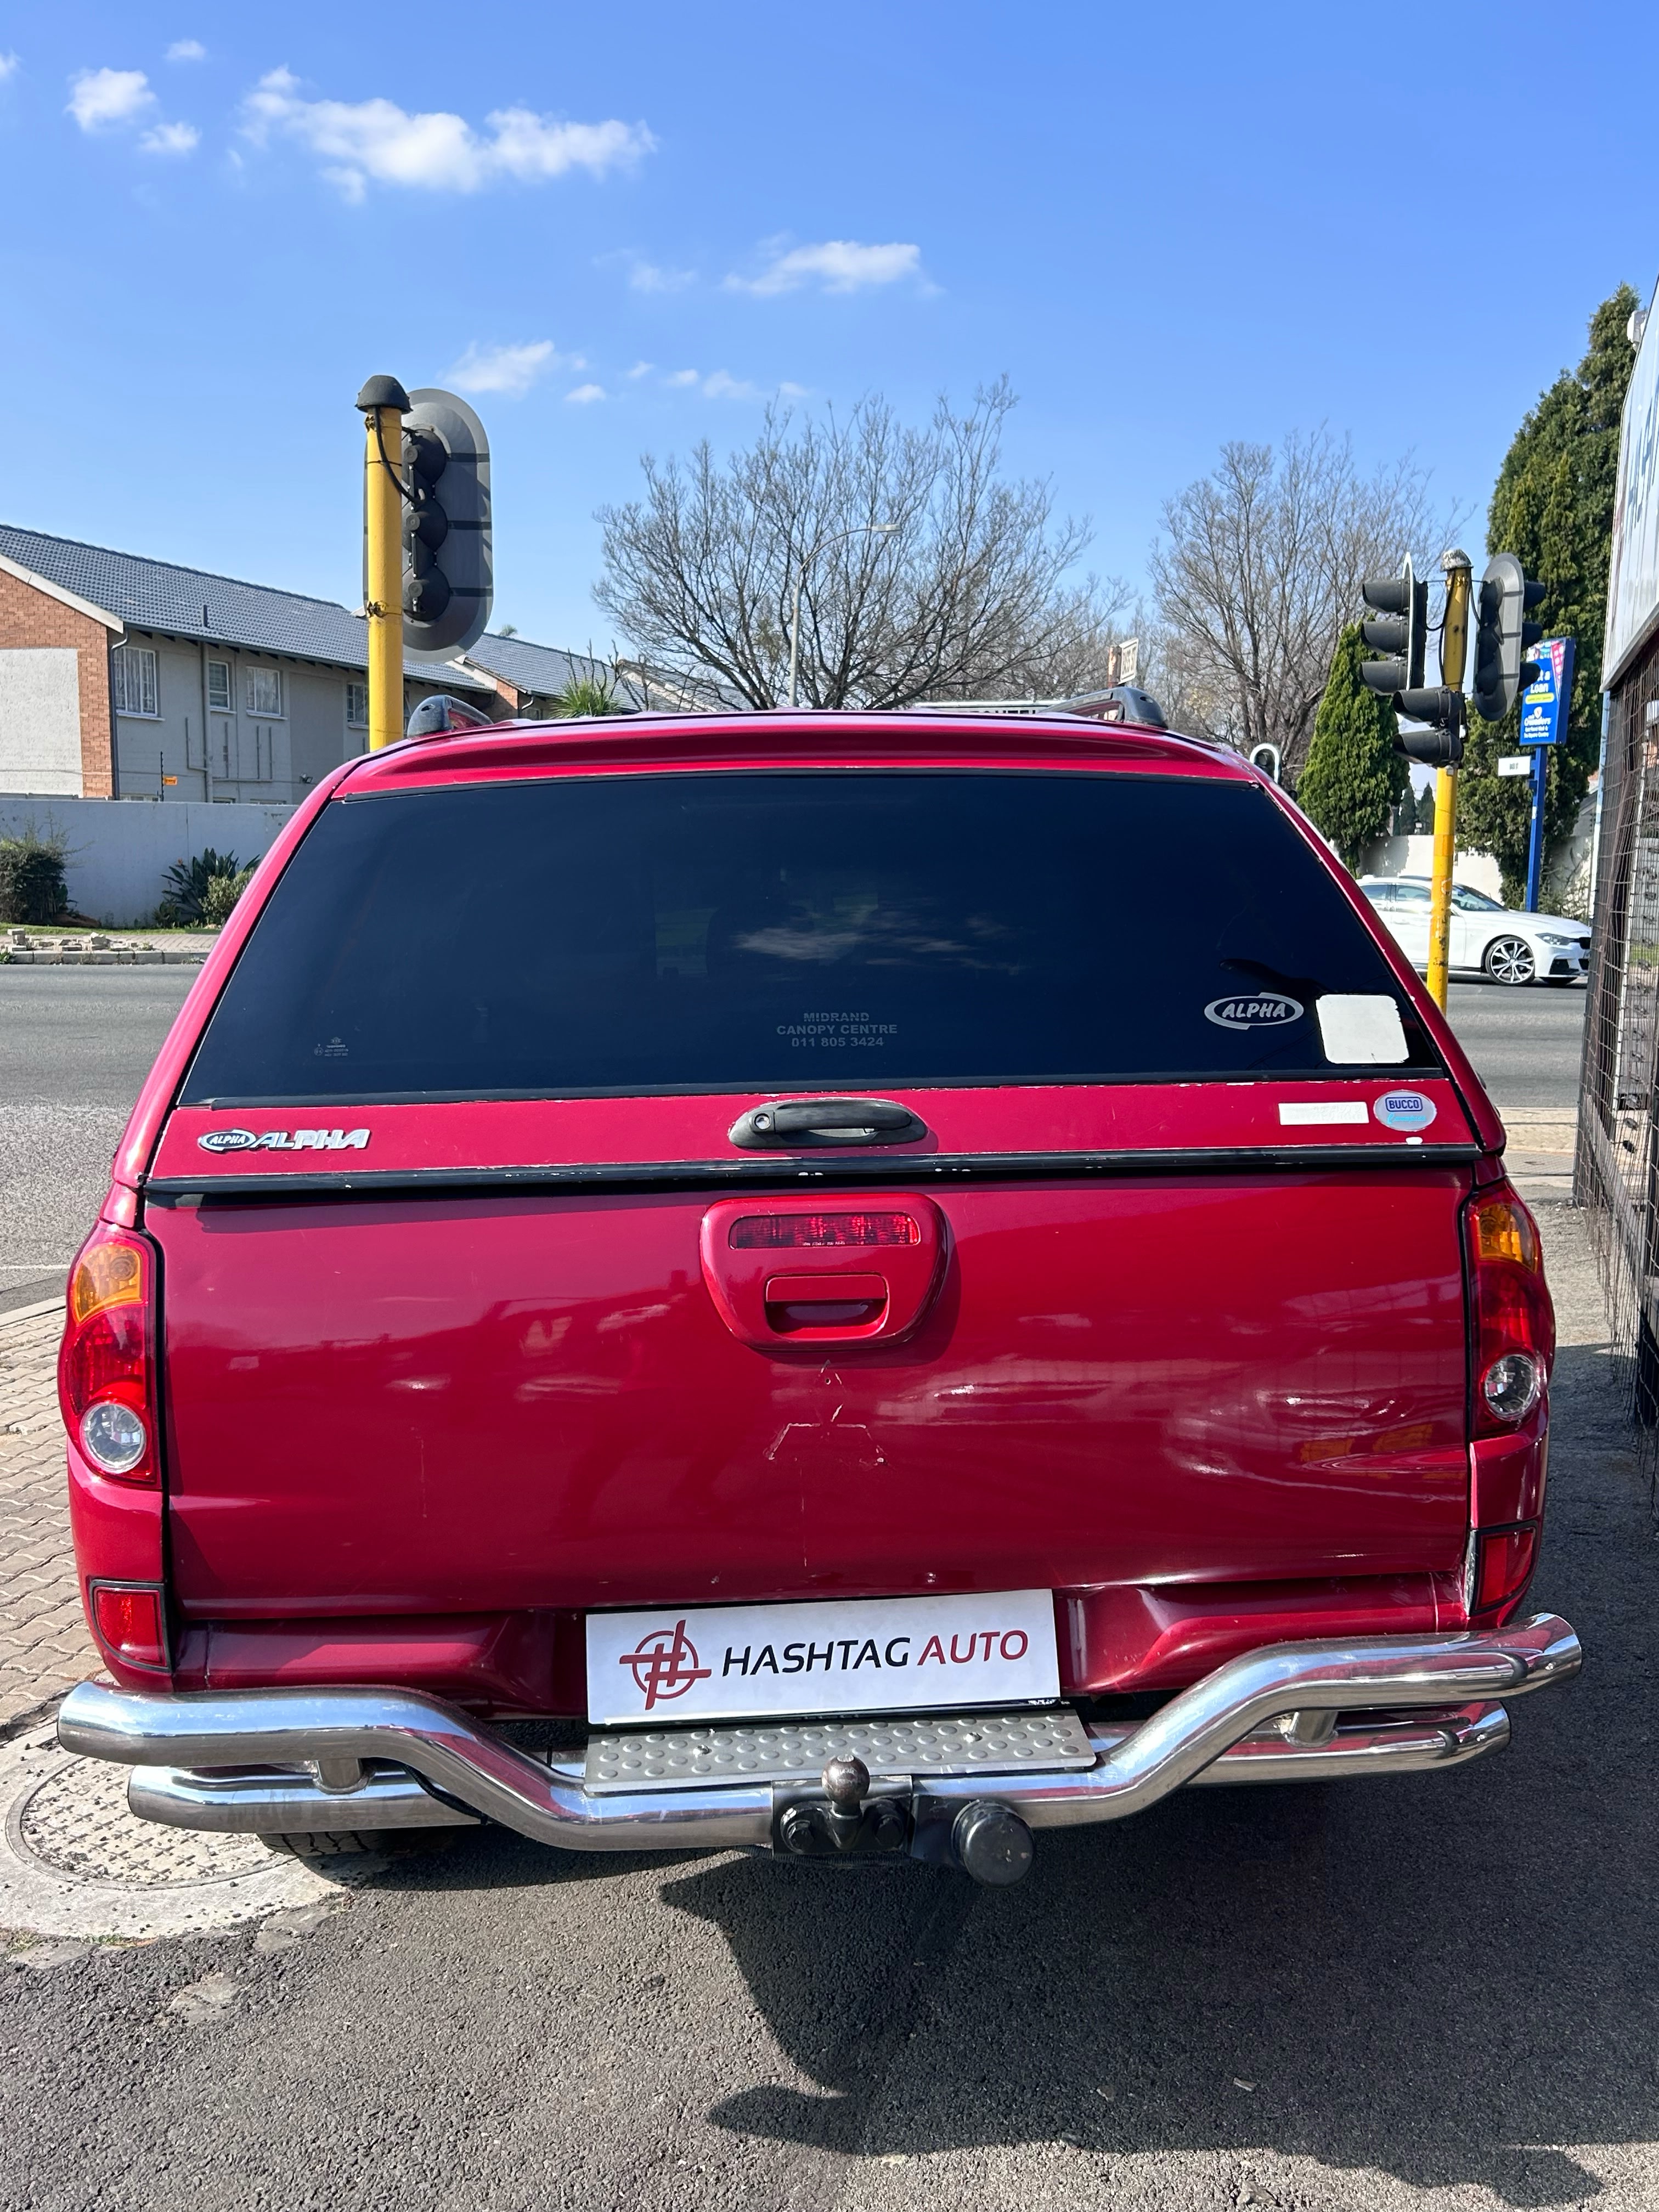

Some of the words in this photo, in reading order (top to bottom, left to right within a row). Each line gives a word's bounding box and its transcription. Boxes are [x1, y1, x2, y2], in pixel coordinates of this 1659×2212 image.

[1530, 683, 1549, 693] Loan
[1221, 1002, 1285, 1018] ALPHA
[803, 1012, 870, 1022] MIDRAND
[776, 1025, 835, 1035] CANOPY
[840, 1024, 898, 1035] CENTRE
[792, 1037, 815, 1047] 011
[821, 1037, 846, 1047] 805
[850, 1037, 884, 1046] 3424
[1389, 1099, 1419, 1109] BUCCO
[209, 1135, 246, 1145] ALPHA
[250, 1128, 371, 1150] ALPHA
[722, 1637, 911, 1677] HASHTAG
[917, 1629, 1028, 1666] AUTO
